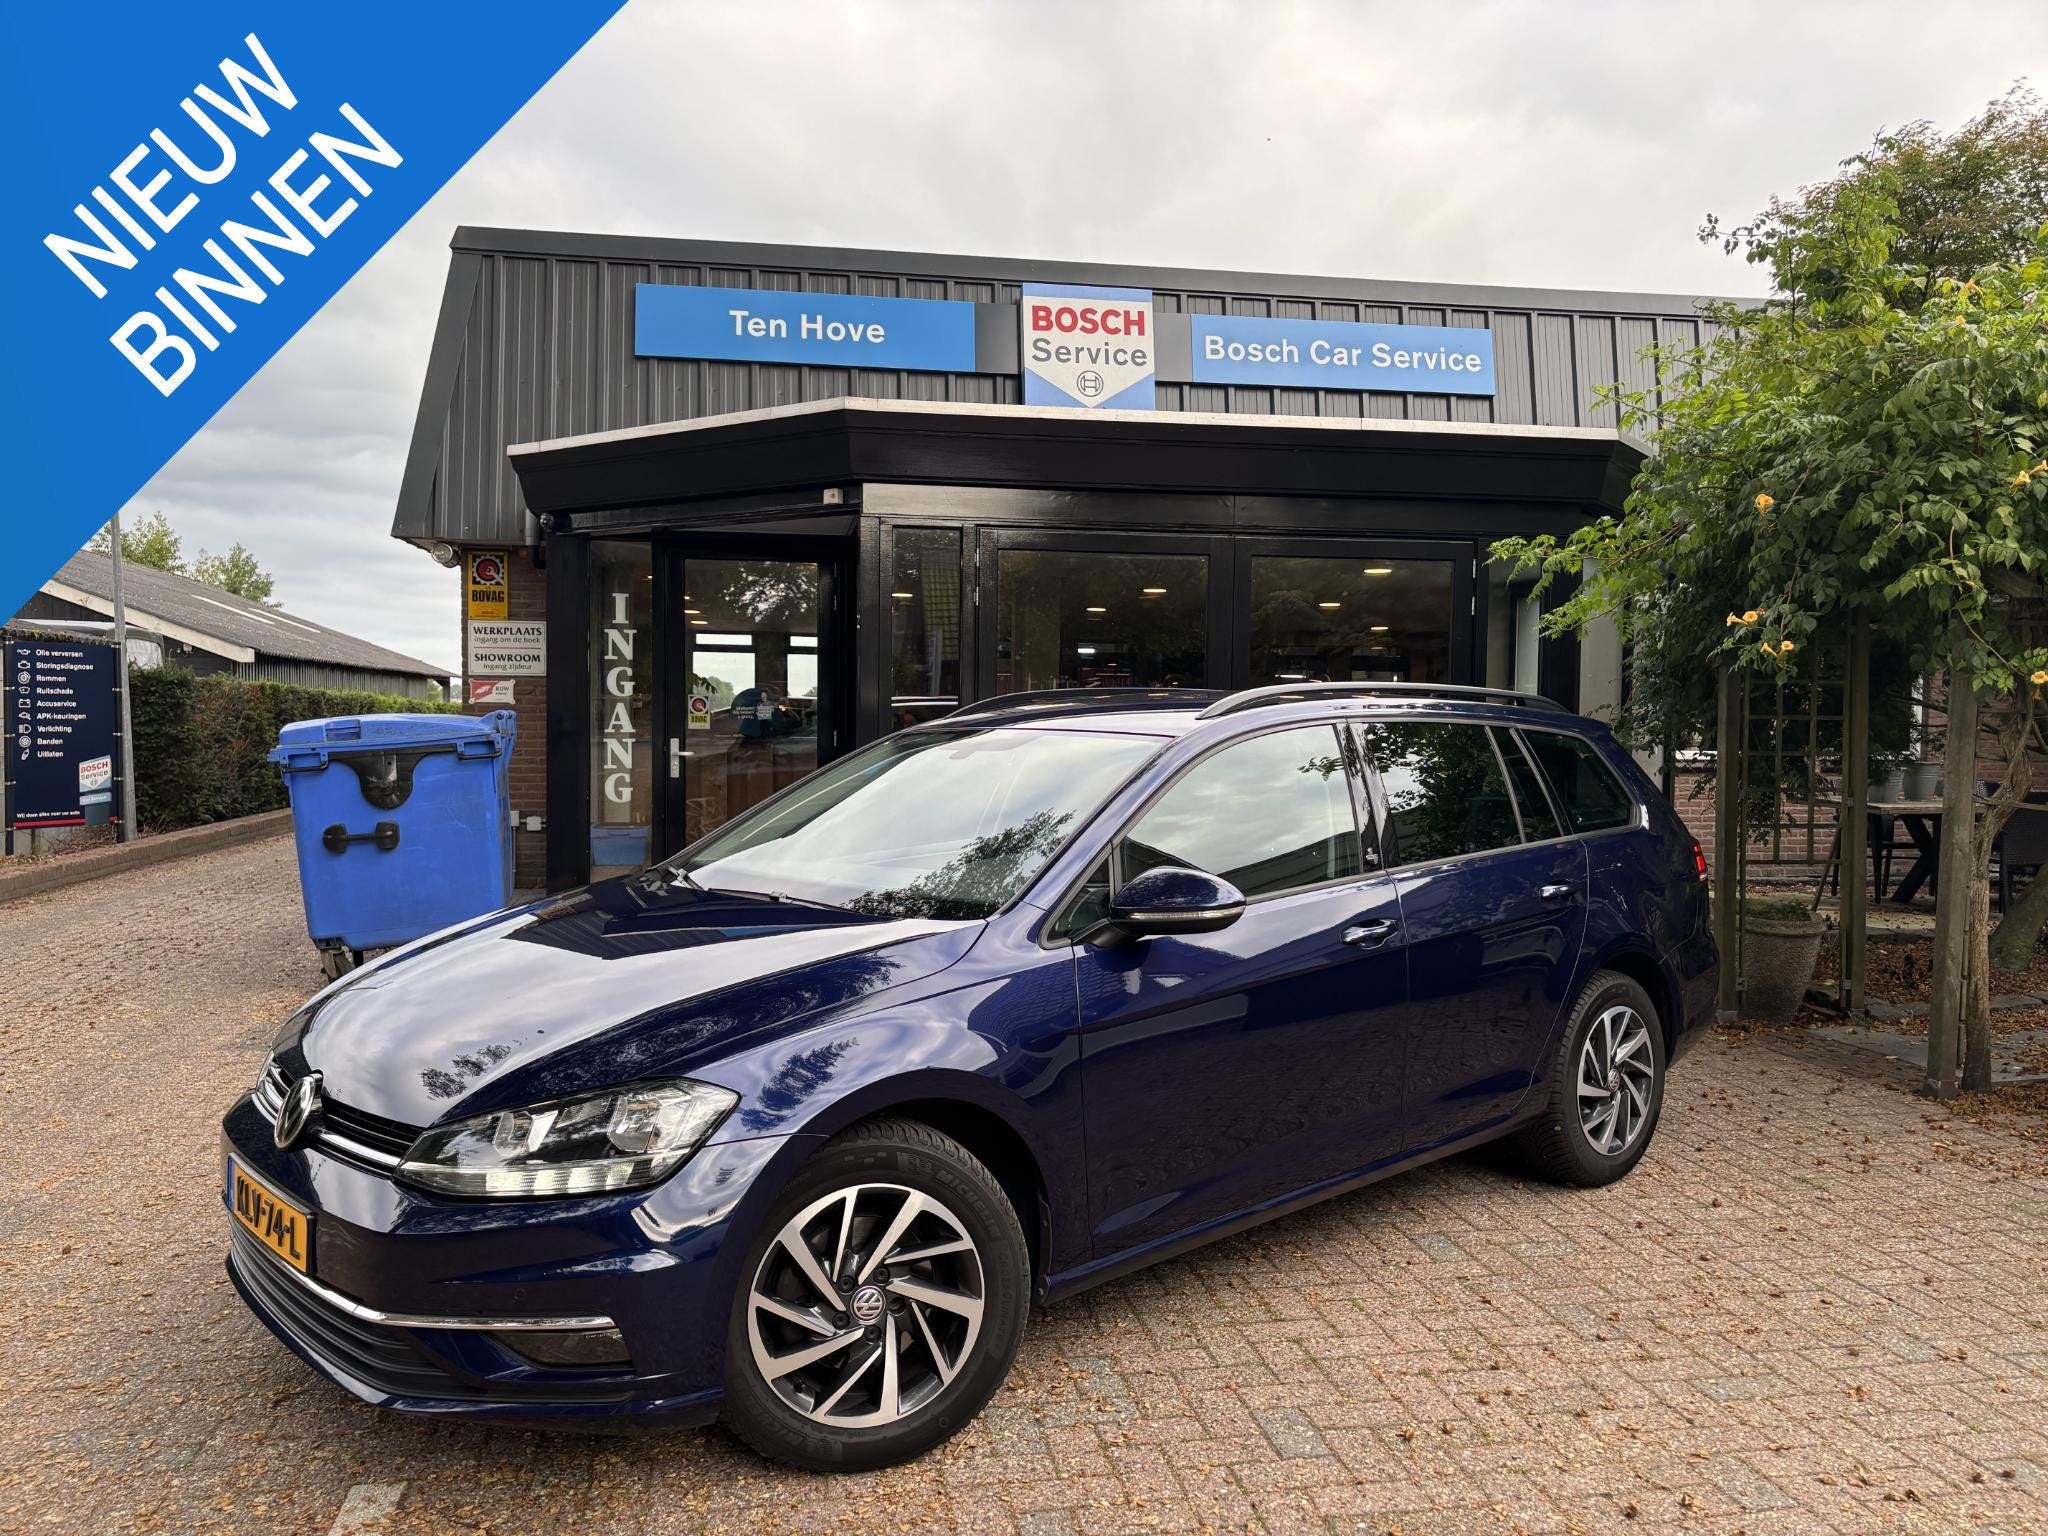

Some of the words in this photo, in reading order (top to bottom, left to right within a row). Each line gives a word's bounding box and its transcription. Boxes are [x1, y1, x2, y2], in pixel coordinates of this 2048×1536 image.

[1031, 305, 1146, 336] BOSCH
[729, 310, 787, 338] Ten
[801, 314, 885, 343] Hove
[1031, 338, 1148, 367] Service
[1205, 335, 1299, 363] Bosch
[1310, 340, 1362, 366] Car
[1371, 343, 1482, 373] Service
[472, 590, 504, 603] BOVAG
[473, 626, 542, 636] WERKPLAATS
[474, 636, 499, 644] ingang
[51, 650, 83, 658] verversen
[474, 653, 541, 662] SHOWROOM
[36, 662, 94, 671] Storingsdiagnose
[483, 663, 507, 671] ingang
[36, 674, 67, 682] Remmen
[36, 687, 74, 695] Ruitschade
[603, 592, 637, 803] INGANG
[36, 712, 87, 721] APK-keuringen
[37, 725, 72, 734] Verlichting
[37, 750, 64, 758] Uitlaten
[80, 761, 108, 774] BOSCH
[81, 769, 109, 781] Service
